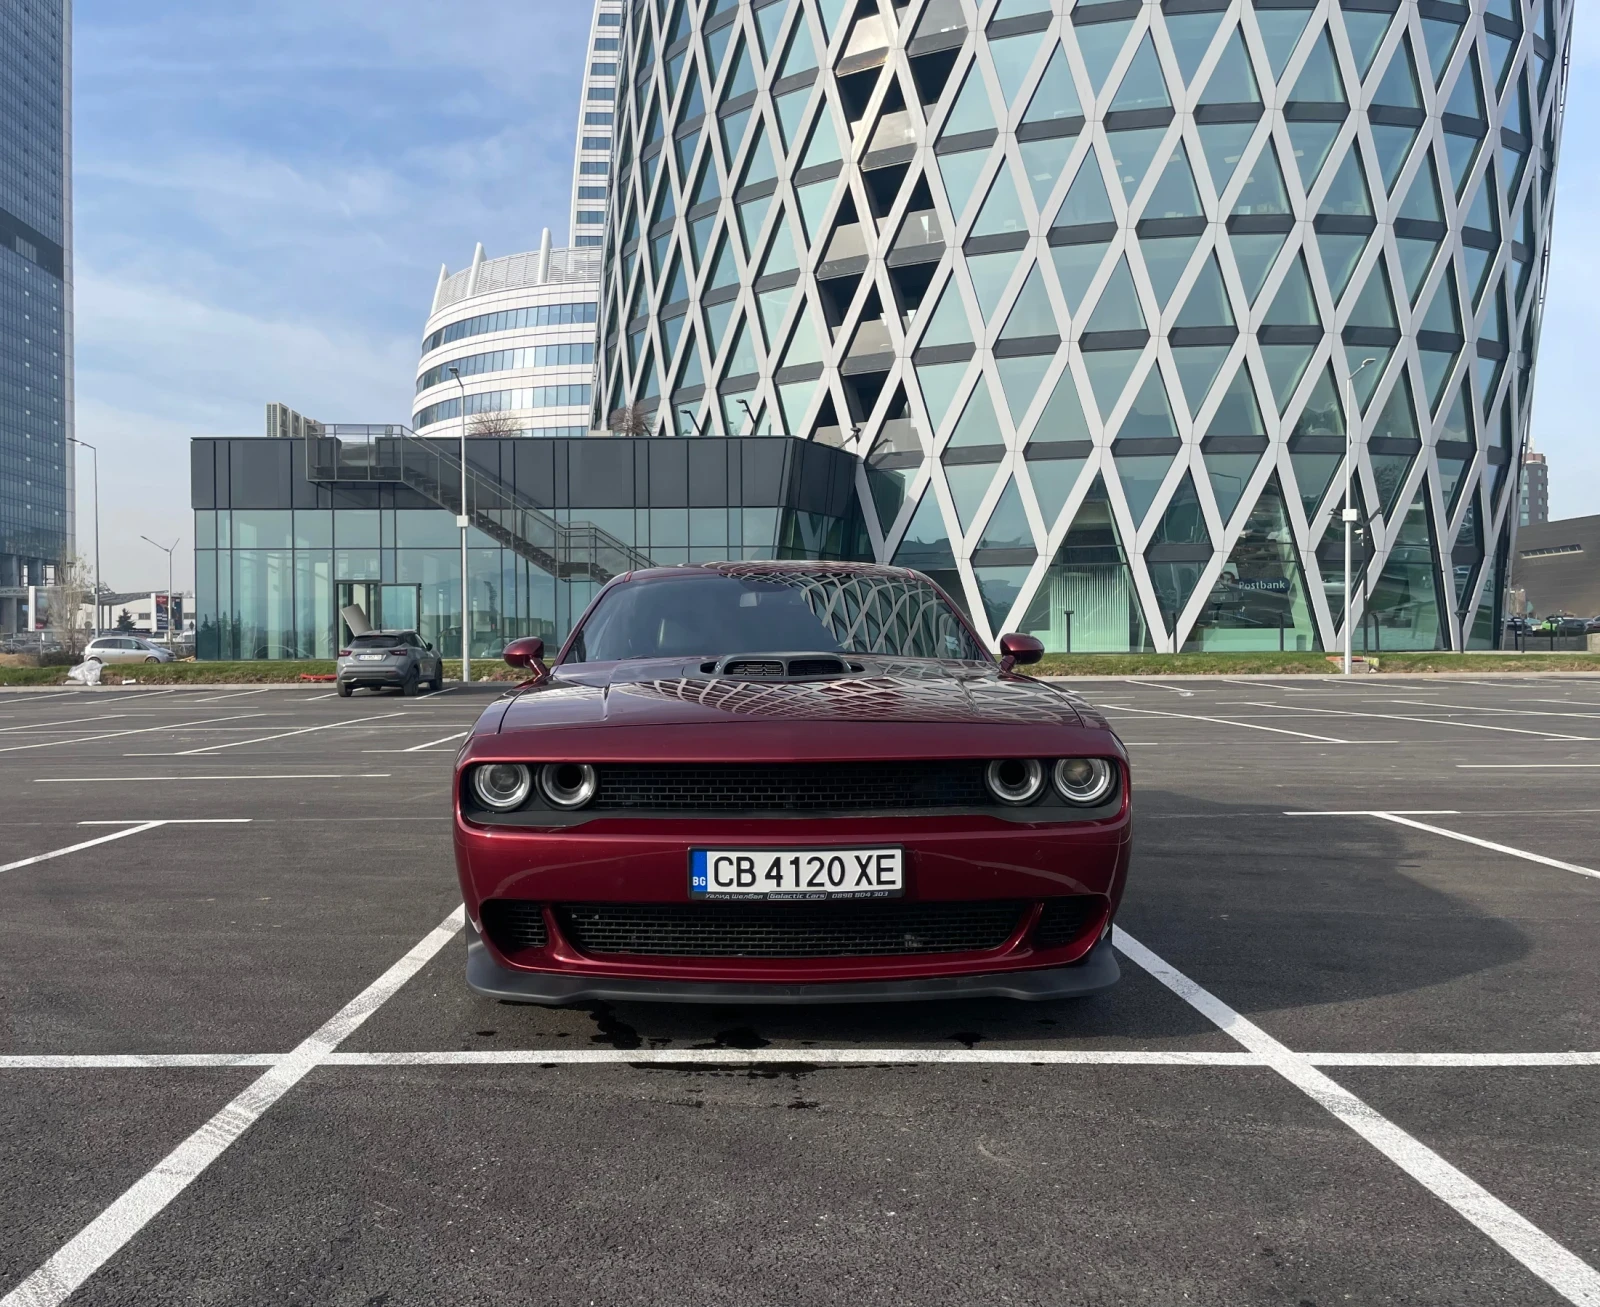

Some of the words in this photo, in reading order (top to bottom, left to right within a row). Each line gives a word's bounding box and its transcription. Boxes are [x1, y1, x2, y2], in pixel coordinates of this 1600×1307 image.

[1239, 580, 1286, 590] Postbank
[714, 856, 757, 887] CB
[765, 855, 846, 887] 4120
[854, 854, 896, 886] XE
[692, 876, 706, 886] BG
